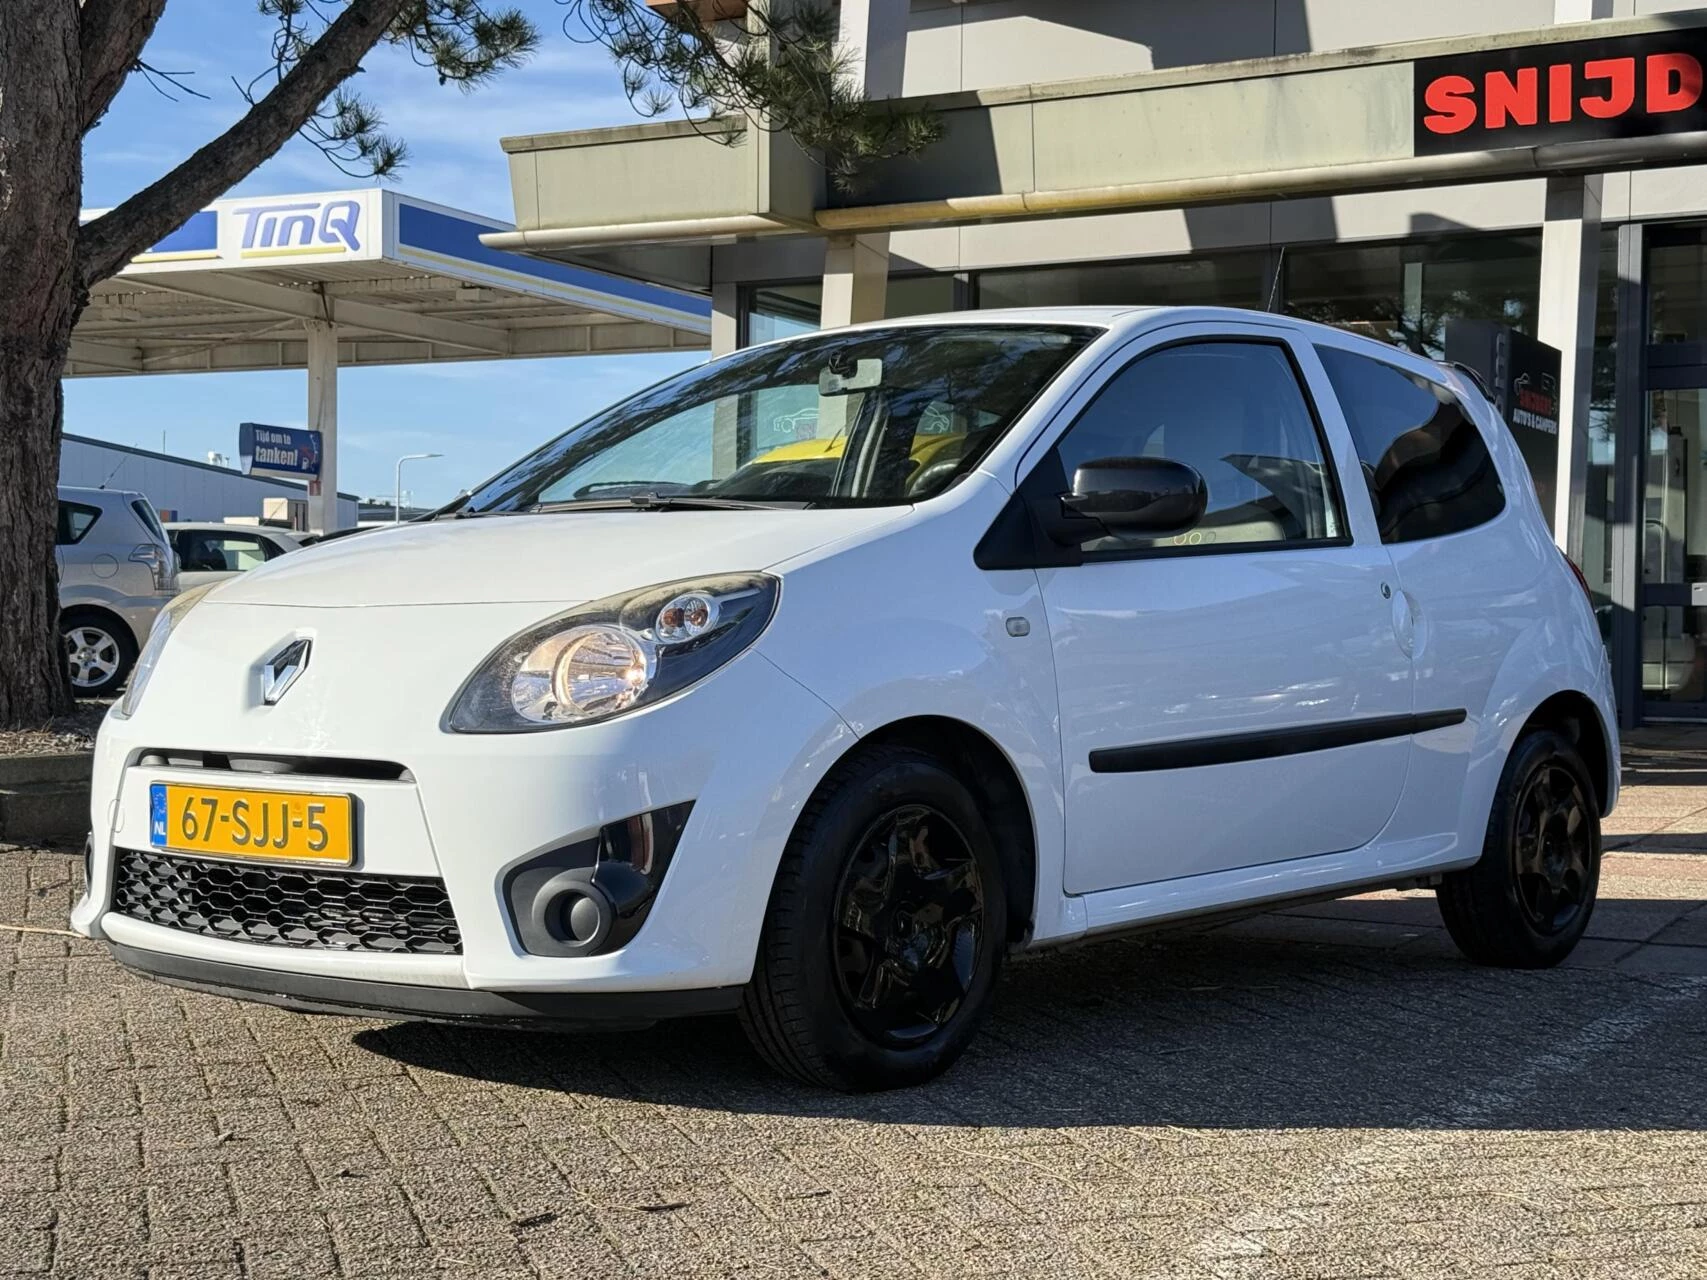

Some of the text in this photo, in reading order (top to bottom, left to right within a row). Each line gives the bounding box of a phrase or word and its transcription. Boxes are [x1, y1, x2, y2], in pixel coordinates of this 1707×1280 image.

[1423, 52, 1703, 135] SNIJD
[255, 429, 292, 445] Tijd om te
[255, 445, 298, 466] tanken!
[153, 796, 329, 851] NL 67-SJJ-5
